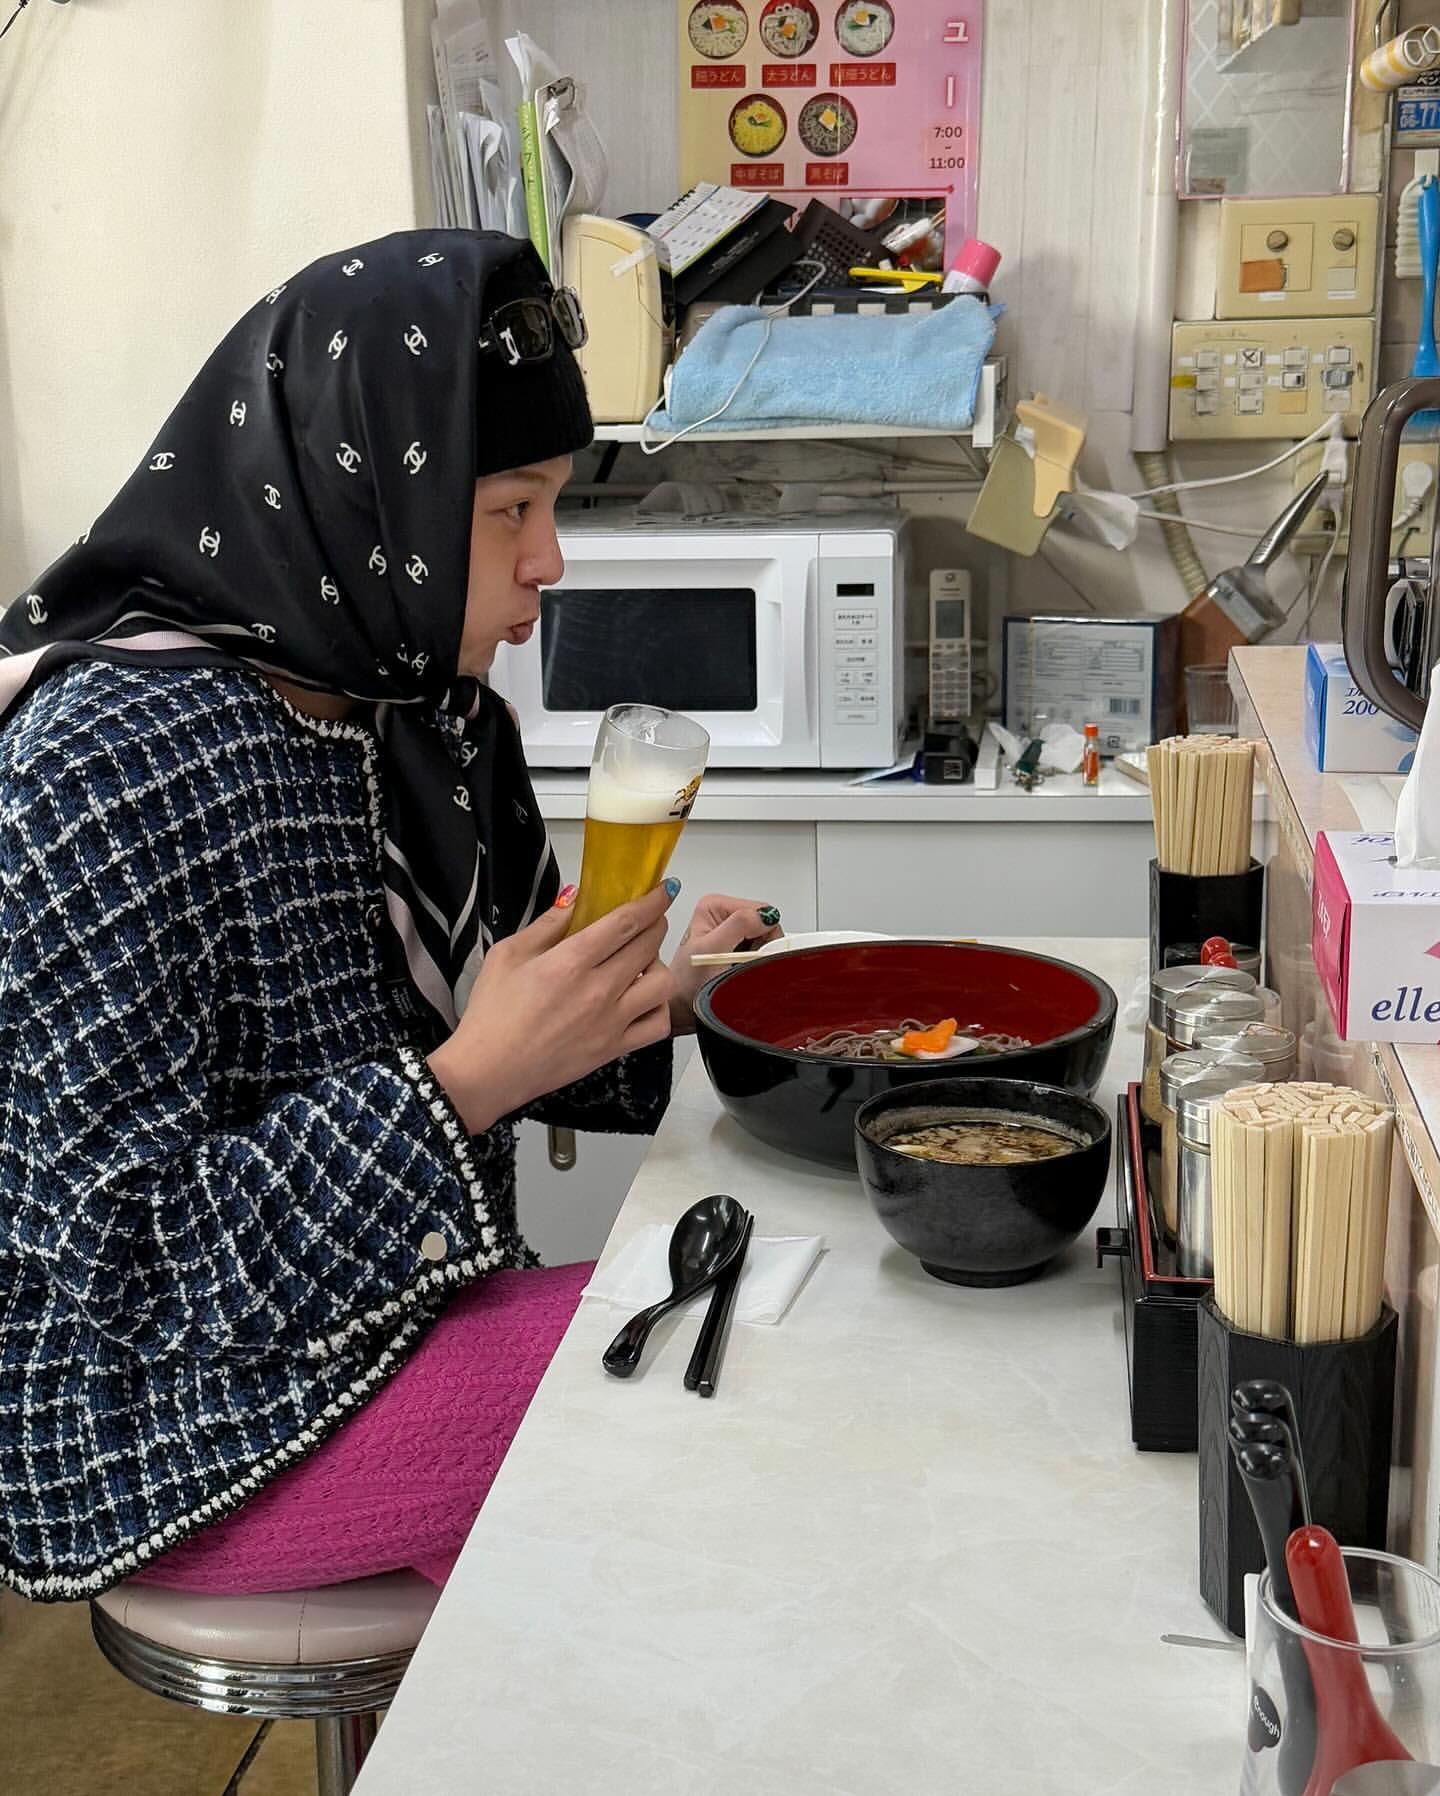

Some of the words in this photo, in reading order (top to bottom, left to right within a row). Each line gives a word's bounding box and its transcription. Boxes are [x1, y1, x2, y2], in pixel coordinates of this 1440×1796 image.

[933, 126, 962, 138] 7:00
[930, 157, 965, 169] 11:00
[1371, 986, 1440, 1022] elle
